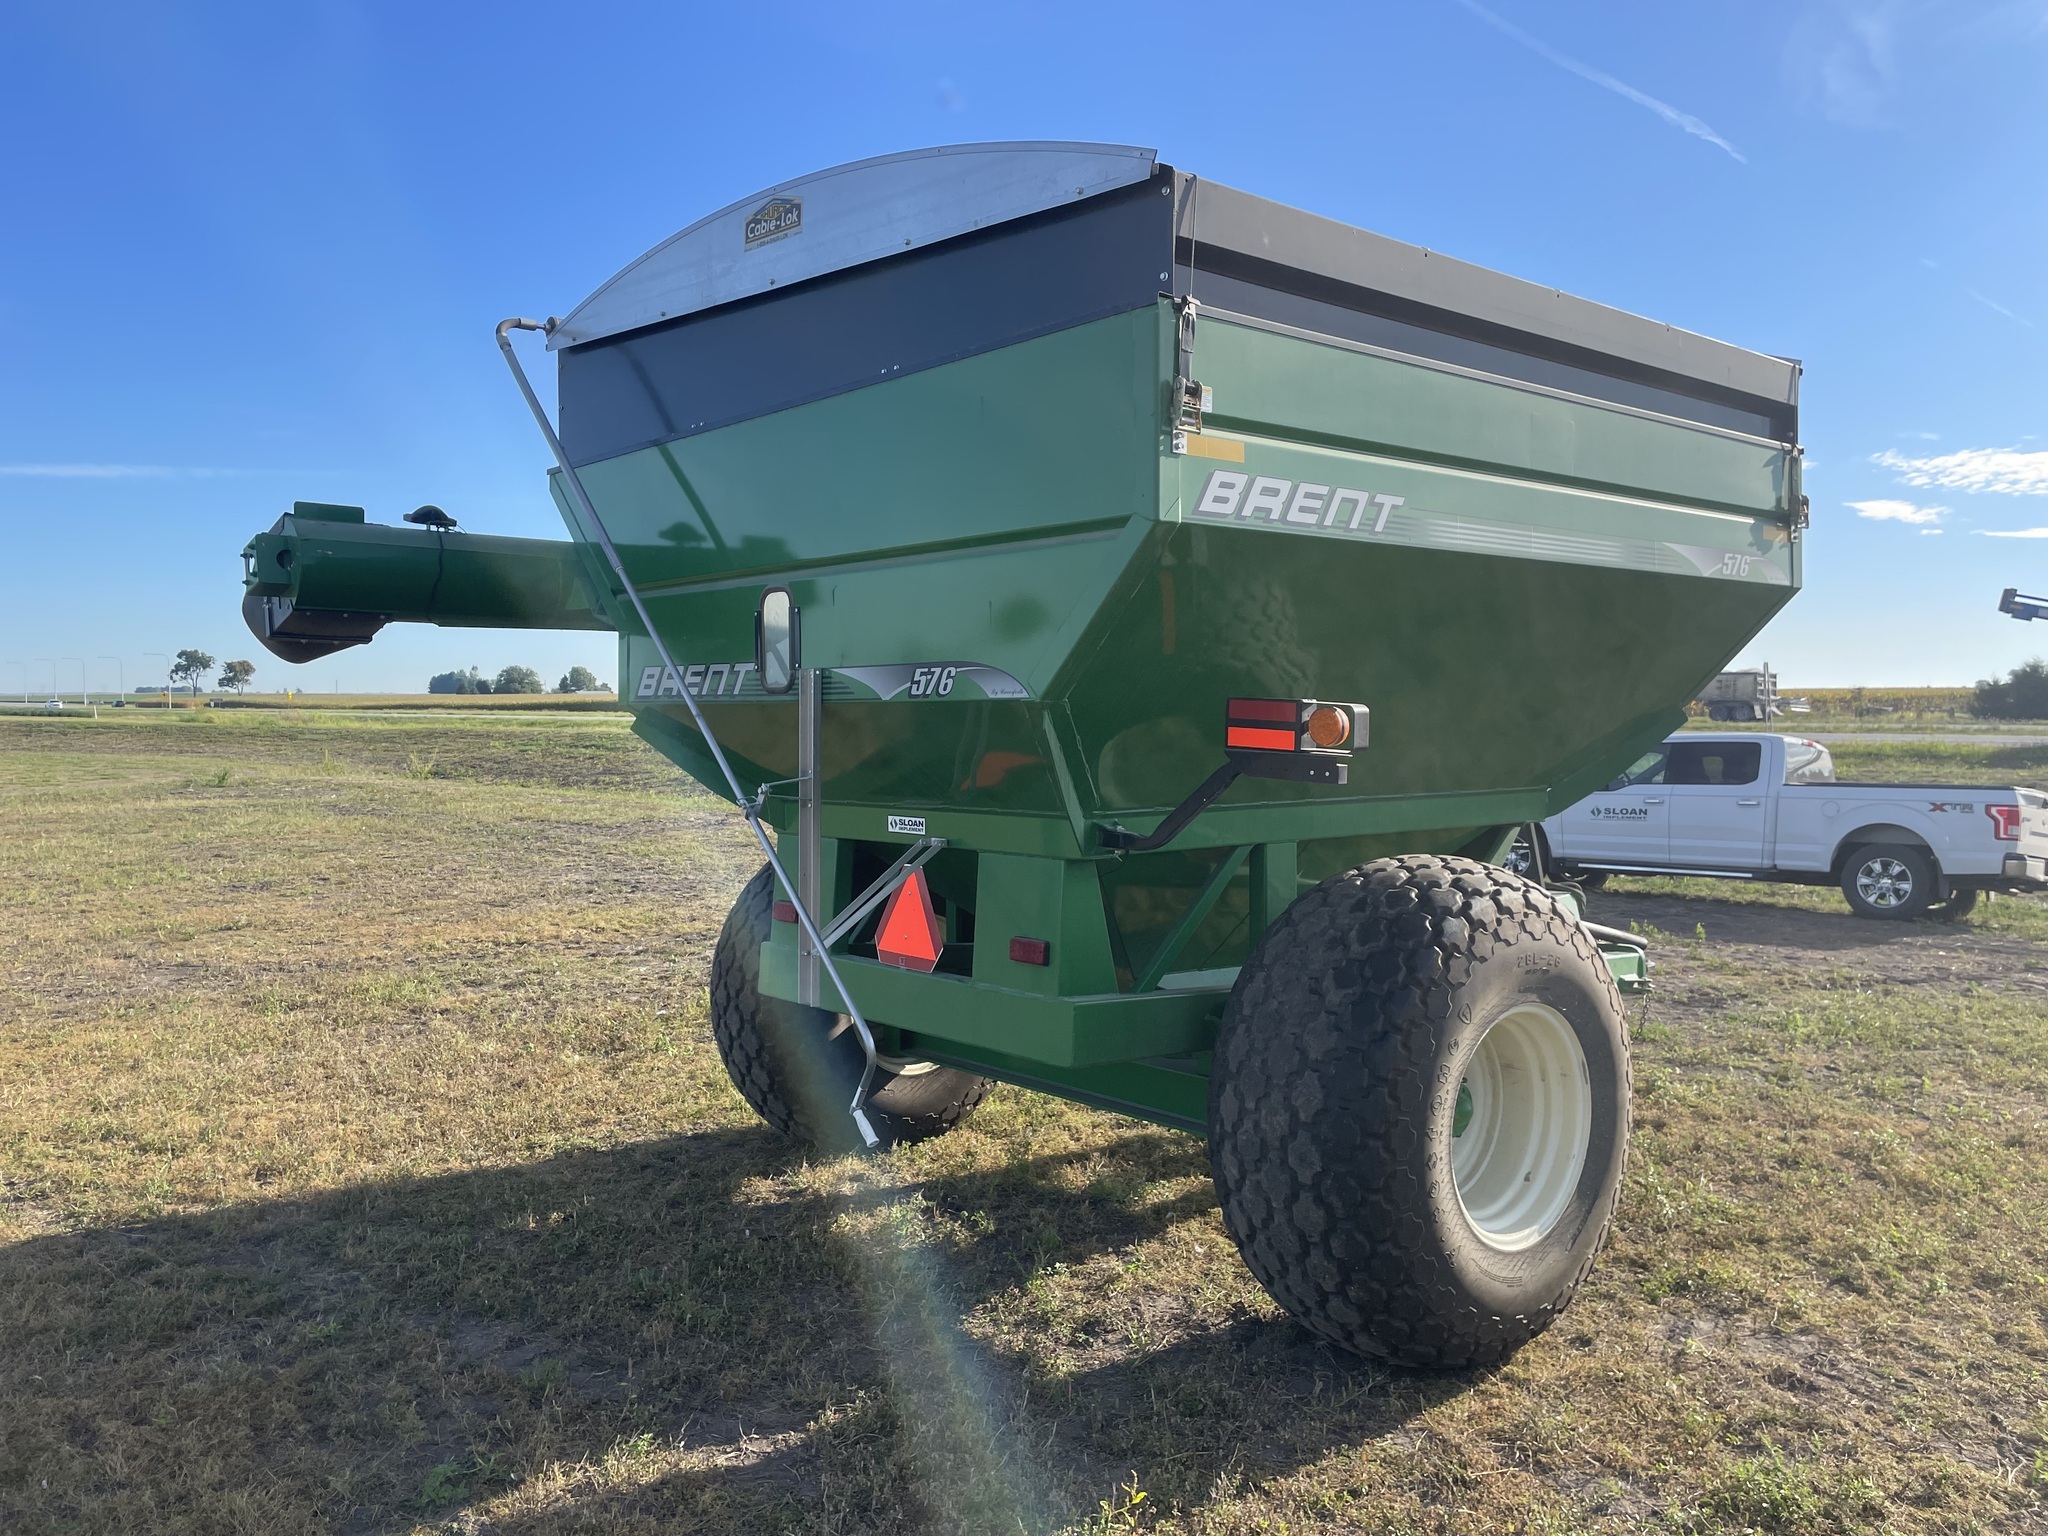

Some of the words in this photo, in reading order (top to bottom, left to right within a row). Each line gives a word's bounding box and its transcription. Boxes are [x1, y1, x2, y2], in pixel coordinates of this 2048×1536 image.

[747, 207, 799, 238] Cable-Lok
[1197, 469, 1406, 533] BRENT
[1722, 553, 1750, 577] 576
[637, 662, 756, 697] BRENT
[910, 666, 957, 697] 576
[898, 818, 924, 828] SLOAN
[1603, 807, 1648, 816] SLOAN
